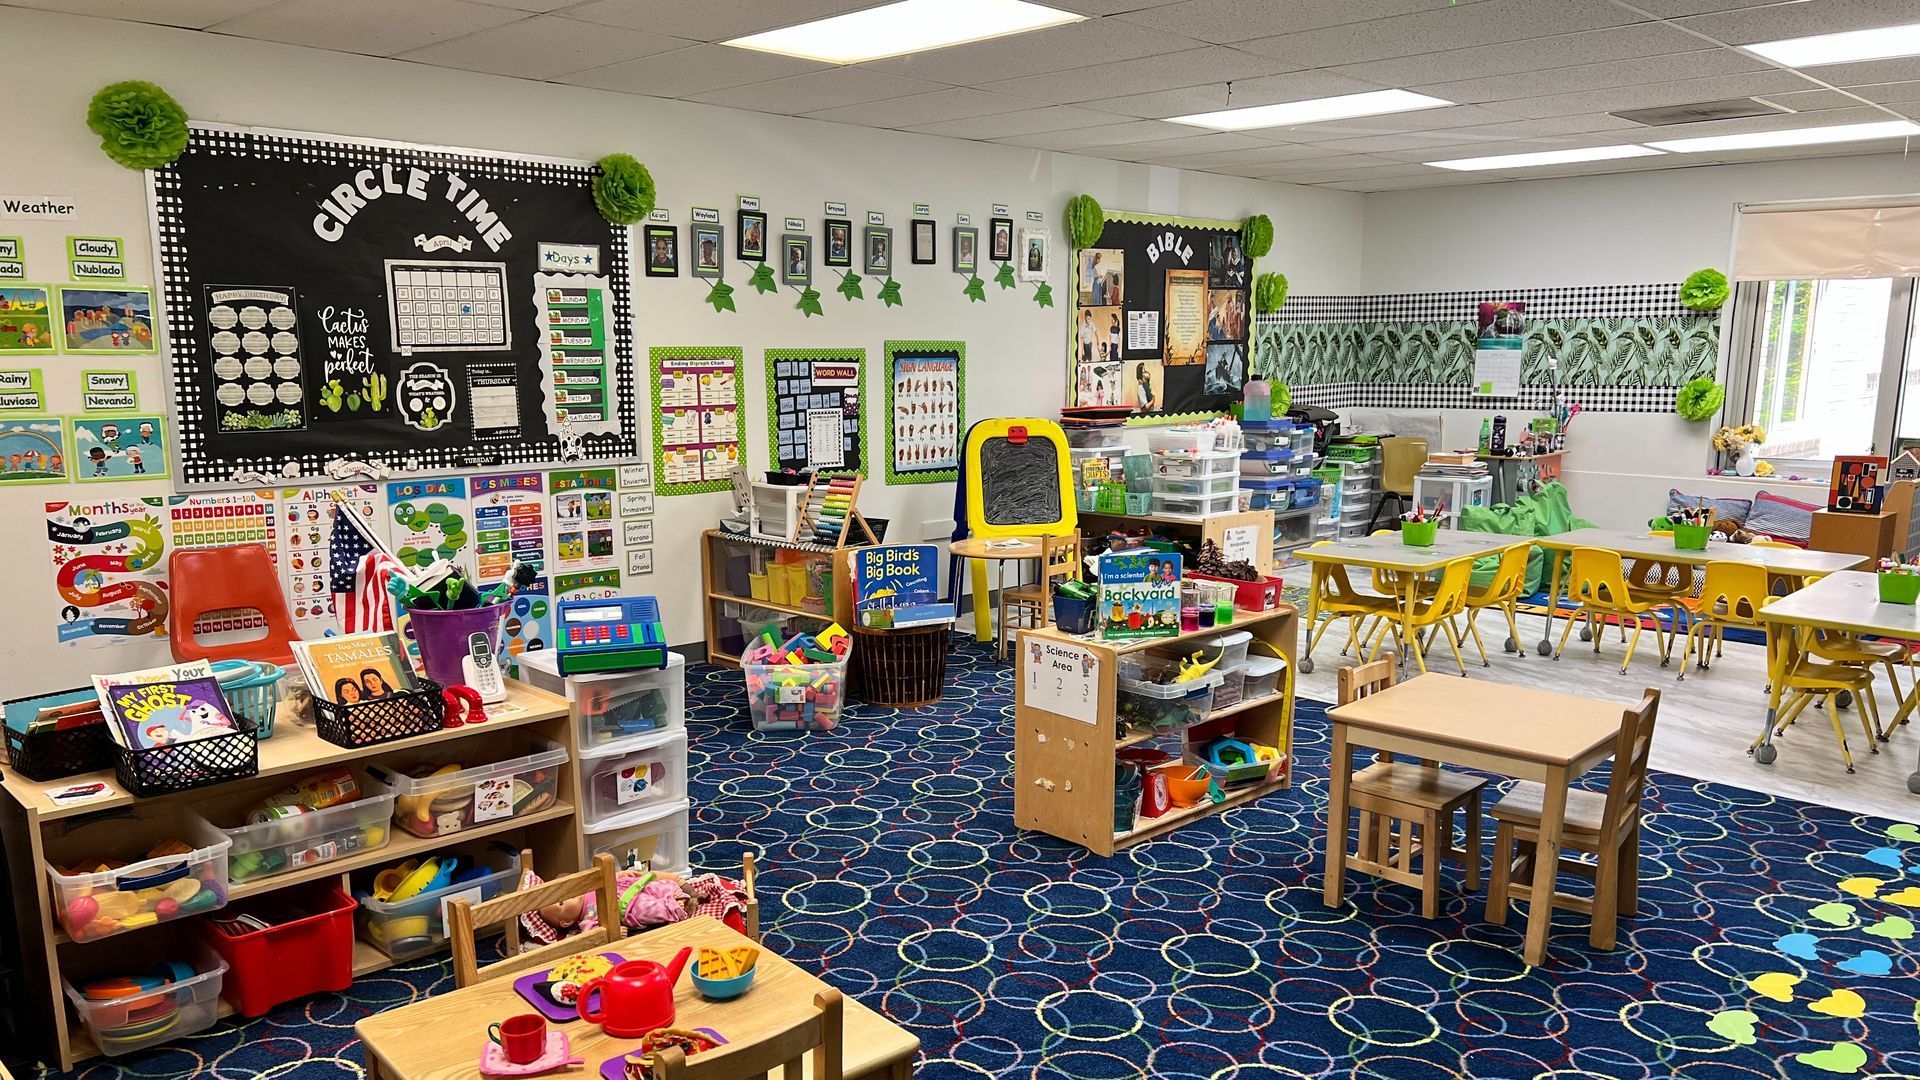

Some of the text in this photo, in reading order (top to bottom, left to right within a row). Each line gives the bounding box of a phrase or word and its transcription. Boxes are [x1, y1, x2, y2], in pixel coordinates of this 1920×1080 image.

[4, 200, 74, 214] Weather
[313, 163, 513, 253] CIRCLE TIME
[79, 243, 113, 255] Cloudy
[1146, 232, 1194, 265] BIBLE
[553, 251, 580, 266] Days
[77, 265, 120, 275] Nublado
[317, 306, 370, 334] Cactus
[327, 336, 366, 349] MAKES
[324, 348, 375, 383] perfect
[899, 361, 953, 372] SIGN LANGUAGE
[816, 368, 855, 376] WORD WALL
[0, 375, 27, 386] Rainy
[91, 377, 124, 387] Snowy
[88, 396, 133, 406] Nevando
[464, 456, 495, 464] TUESDAY
[474, 476, 538, 490] LOS MESES
[553, 477, 613, 488] ESTACIONES
[303, 488, 359, 502] Alphet
[396, 486, 421, 496] LOS
[189, 496, 230, 505] Numbers
[69, 502, 129, 516] Months
[129, 507, 147, 515] year
[57, 532, 84, 540] January
[95, 528, 122, 537] February
[866, 549, 920, 566] Big Bird's
[866, 563, 920, 580] Big Book
[905, 577, 928, 587] Counting
[68, 591, 82, 600] July
[102, 589, 122, 598] August
[605, 590, 611, 598] D
[1105, 587, 1174, 602] Backyard
[324, 646, 392, 663] TAMALES
[1046, 645, 1079, 660] Science
[1052, 660, 1072, 672] Area
[1033, 672, 1089, 697] 1 2 3
[116, 685, 176, 708] MY FIRST
[124, 693, 192, 722] GHOST
